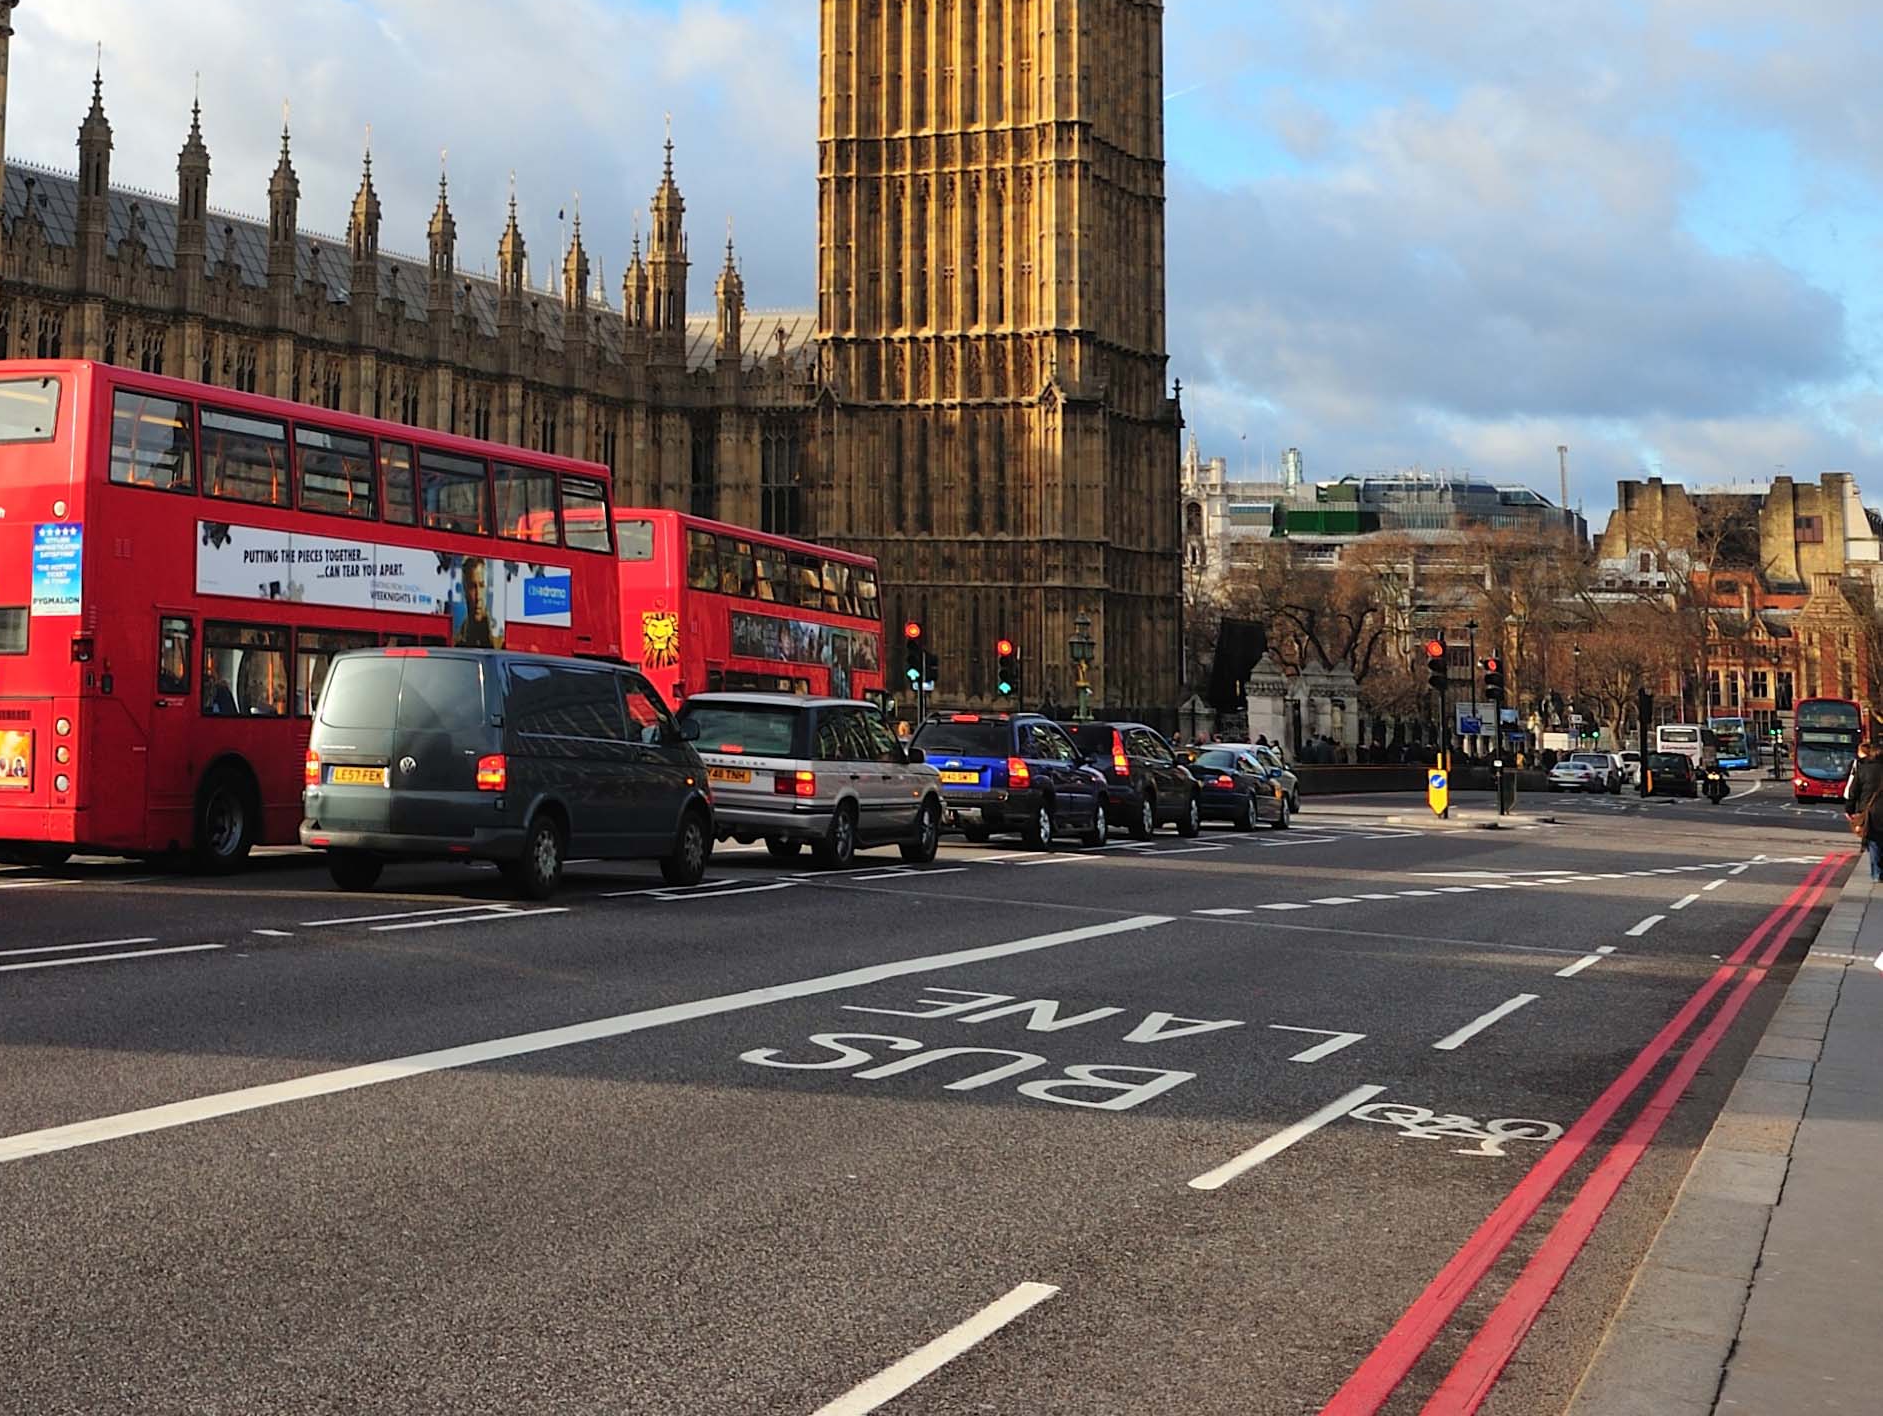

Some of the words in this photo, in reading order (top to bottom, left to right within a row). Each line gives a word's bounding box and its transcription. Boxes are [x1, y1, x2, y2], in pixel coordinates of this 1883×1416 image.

[243, 549, 279, 564] PUTTING
[281, 550, 296, 563] THE
[297, 550, 323, 563] PIECES
[342, 564, 361, 577] TEAR
[362, 564, 377, 577] YOU
[379, 563, 405, 576] APART.
[33, 596, 80, 605] PYGMALION
[370, 590, 411, 603] WEEKNIGHTS
[841, 987, 1367, 1063] LANE
[738, 1032, 1197, 1111] BUS
